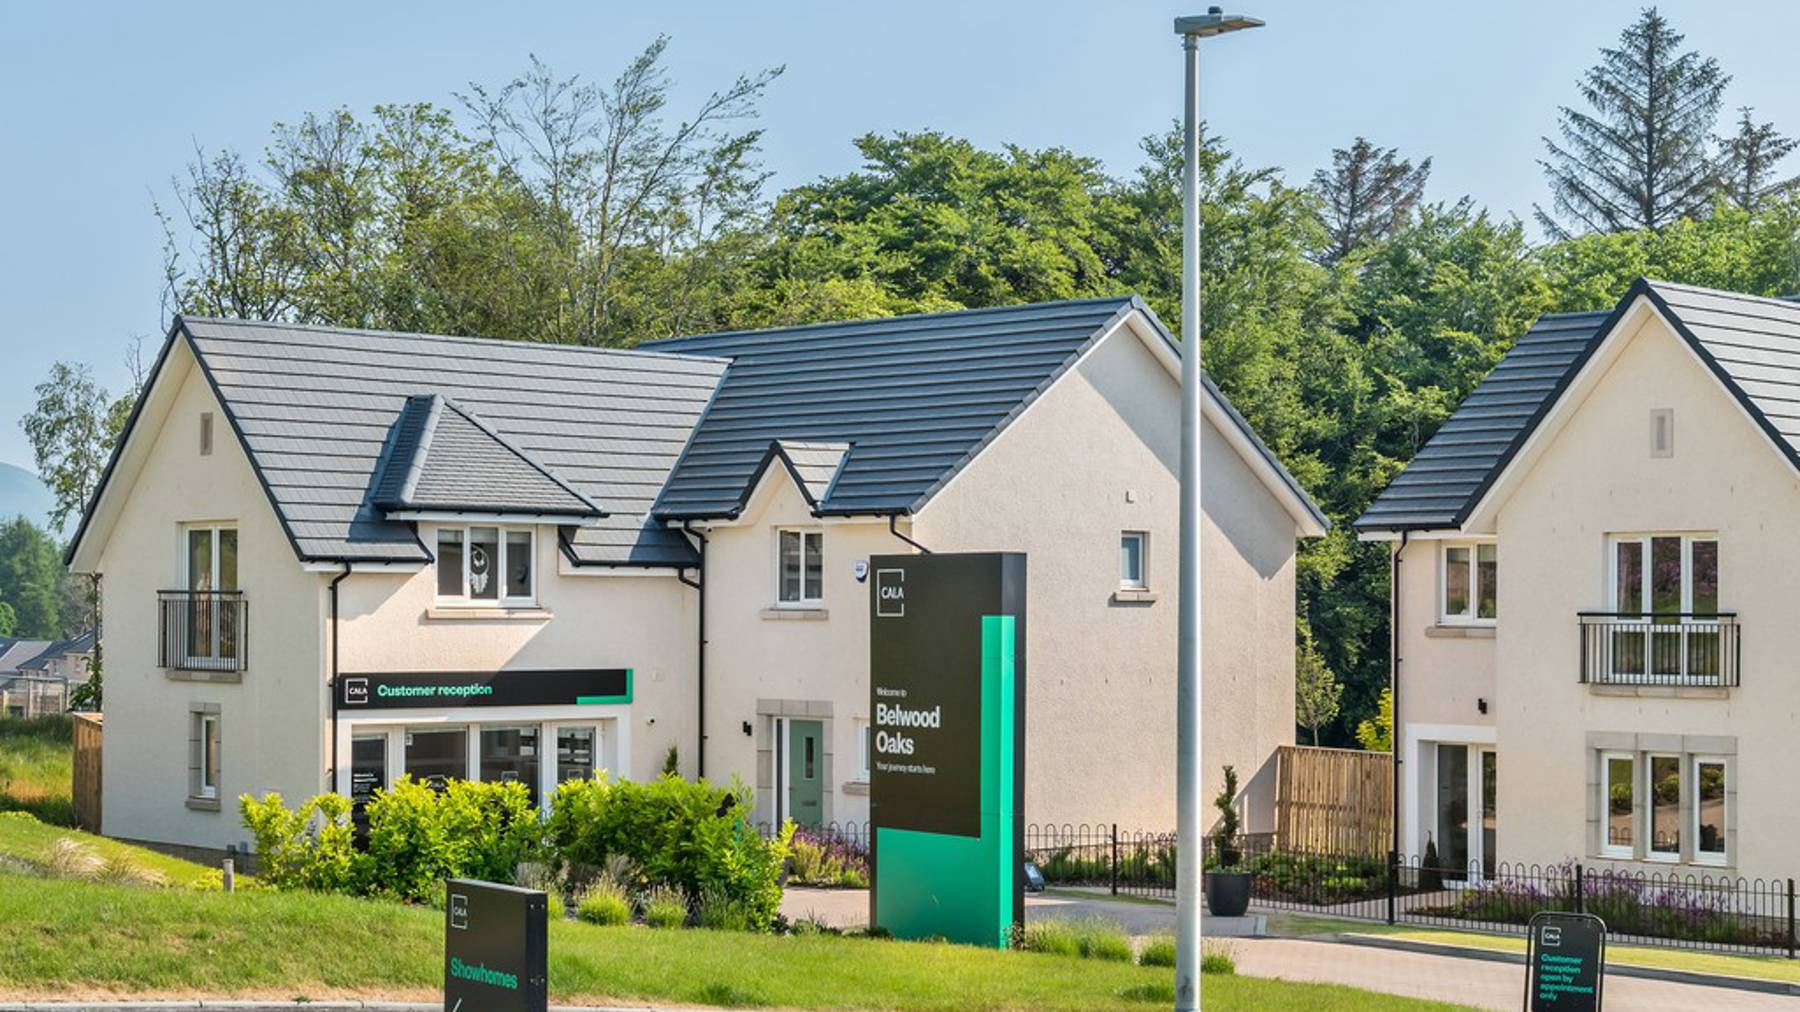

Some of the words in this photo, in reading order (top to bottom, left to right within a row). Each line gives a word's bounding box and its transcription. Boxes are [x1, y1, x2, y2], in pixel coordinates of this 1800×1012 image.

[881, 586, 904, 599] CALA
[349, 687, 368, 695] CALA
[377, 684, 436, 697] Customer
[438, 683, 493, 697] reception
[876, 687, 900, 697] Welcome
[901, 689, 907, 697] to
[876, 703, 940, 728] Belwood
[876, 730, 914, 755] Oaks
[876, 761, 888, 771] Your
[907, 764, 922, 774] starts
[922, 764, 936, 775] here
[1541, 954, 1583, 963] Customer
[451, 956, 518, 989] Showhomes
[1540, 964, 1581, 974] reception
[1540, 974, 1561, 982] open
[1562, 974, 1574, 984] by
[1540, 984, 1594, 994] appointment
[1539, 992, 1558, 1001] only
